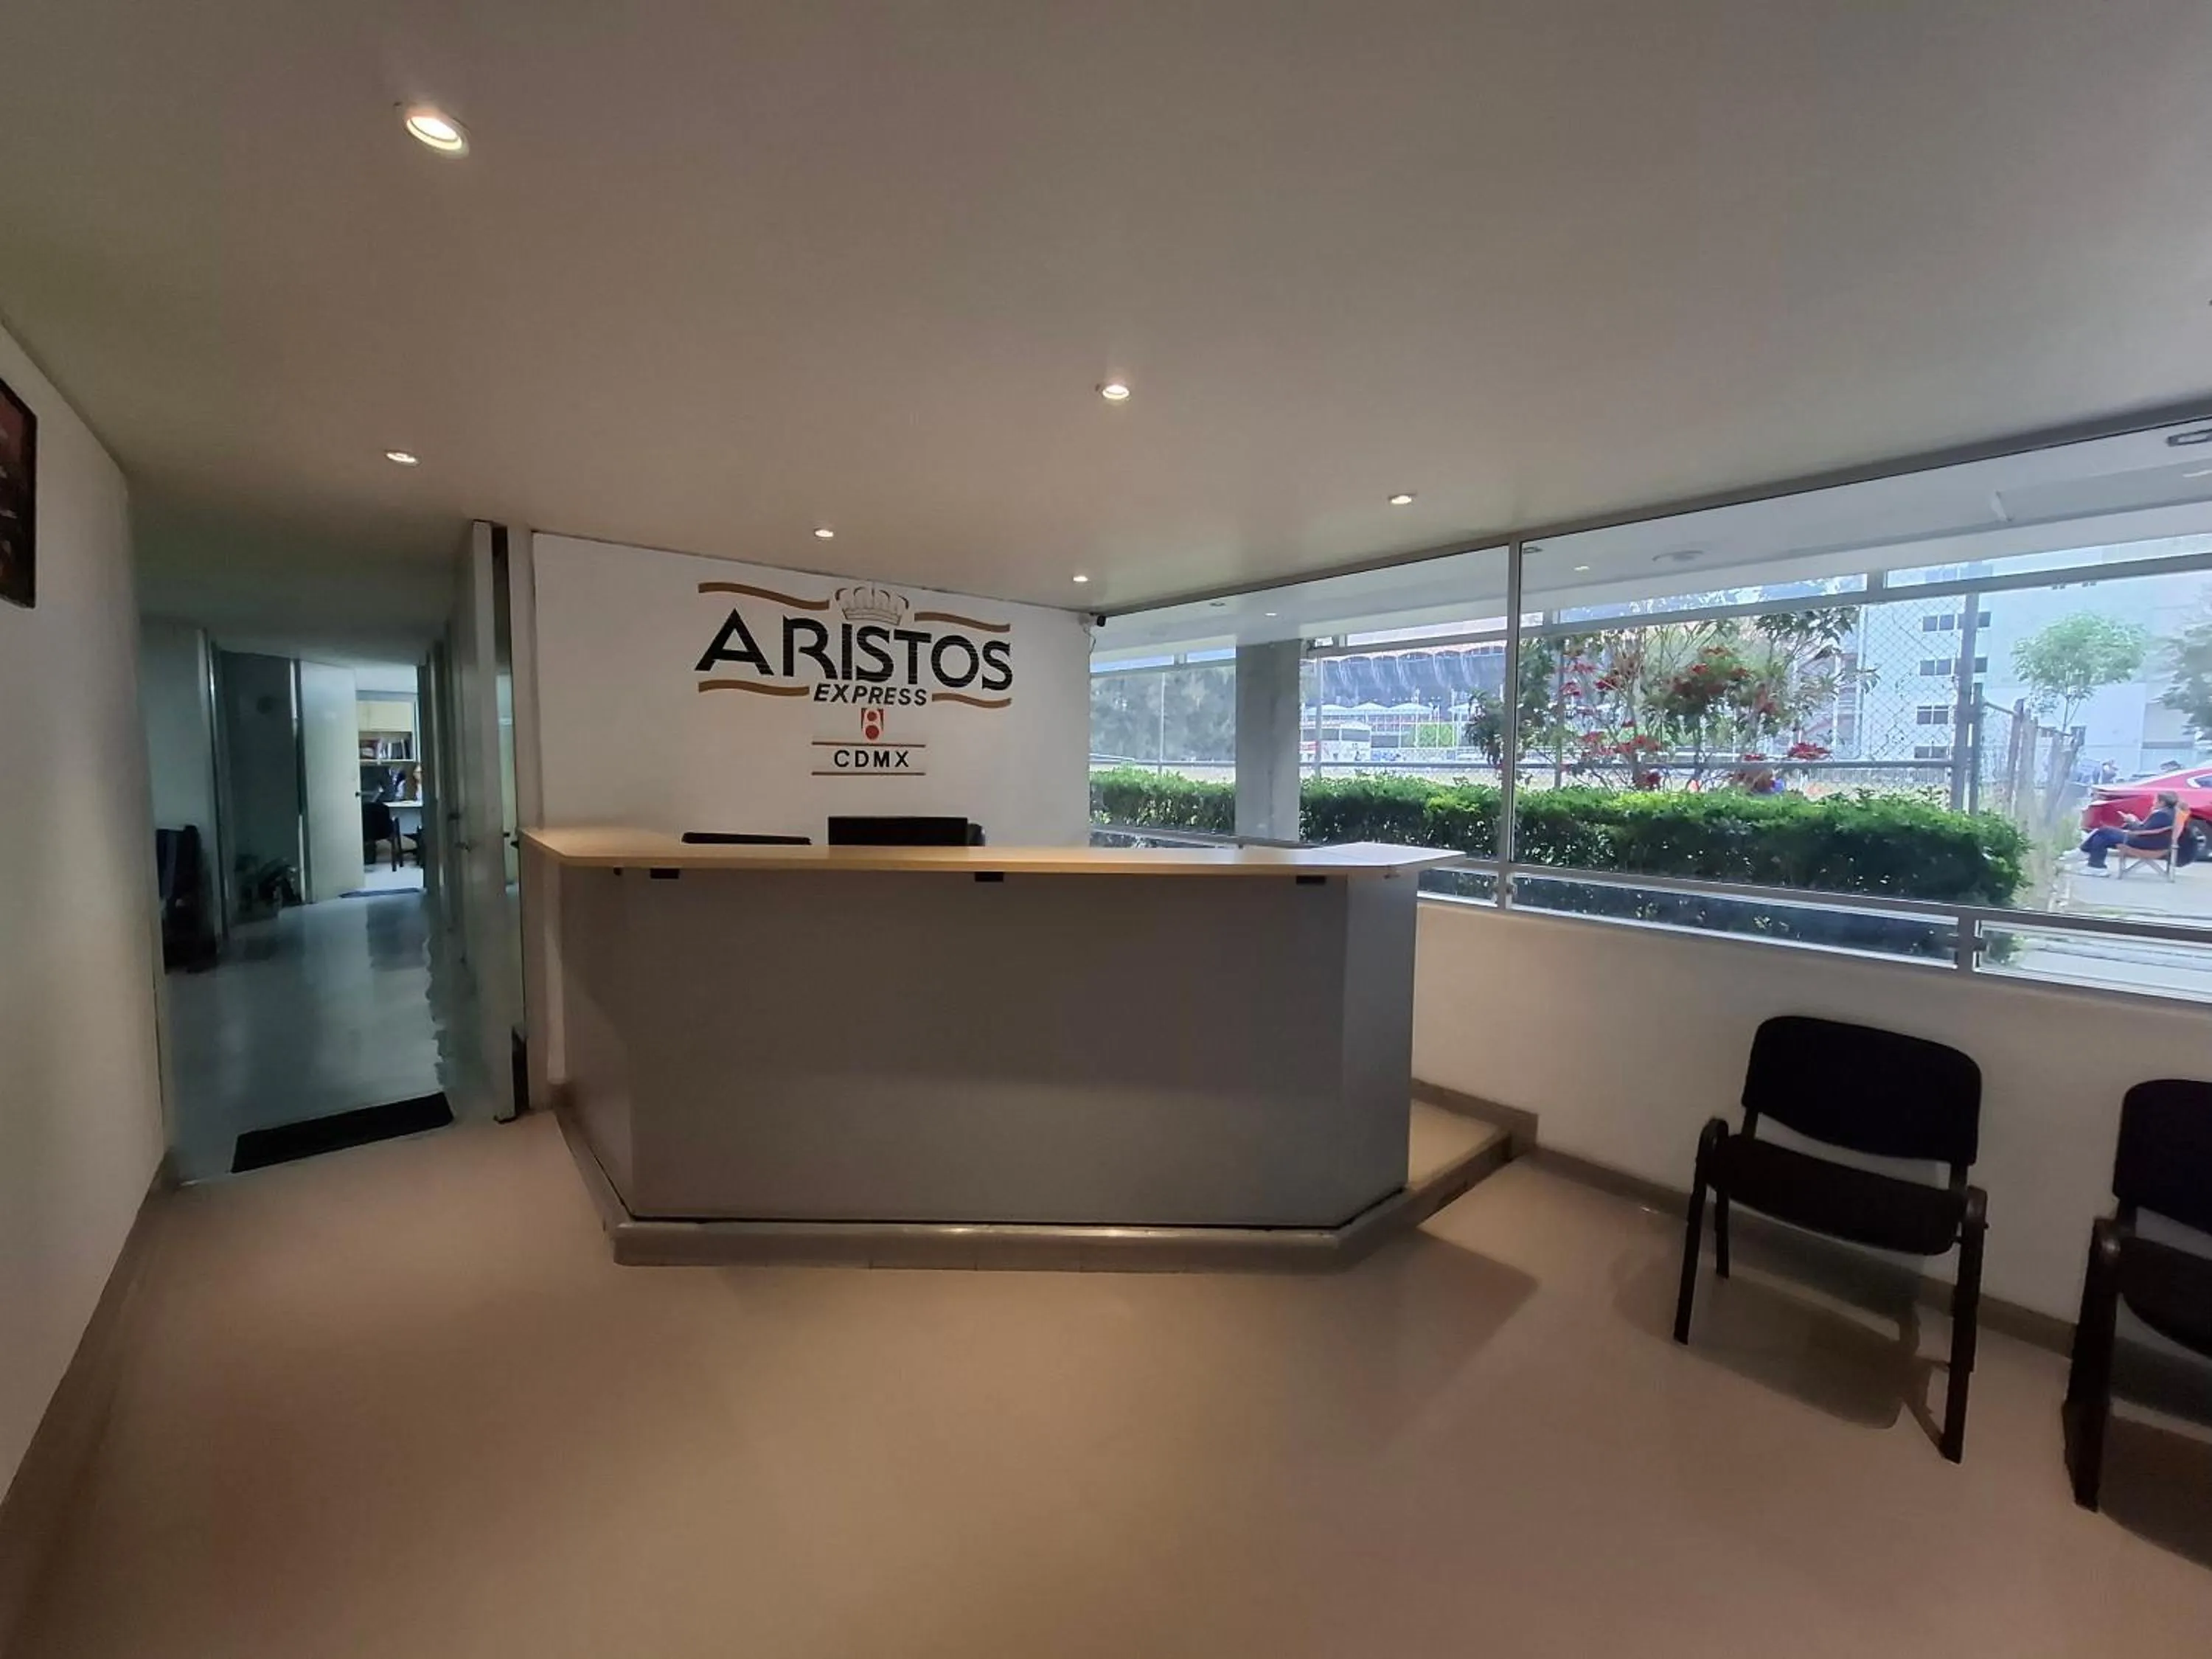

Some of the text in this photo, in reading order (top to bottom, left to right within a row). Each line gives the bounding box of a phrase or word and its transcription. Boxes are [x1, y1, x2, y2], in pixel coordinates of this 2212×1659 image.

[695, 608, 1014, 691] ARISTOS
[813, 683, 928, 706] EXPRESS
[833, 749, 909, 768] CDMX
